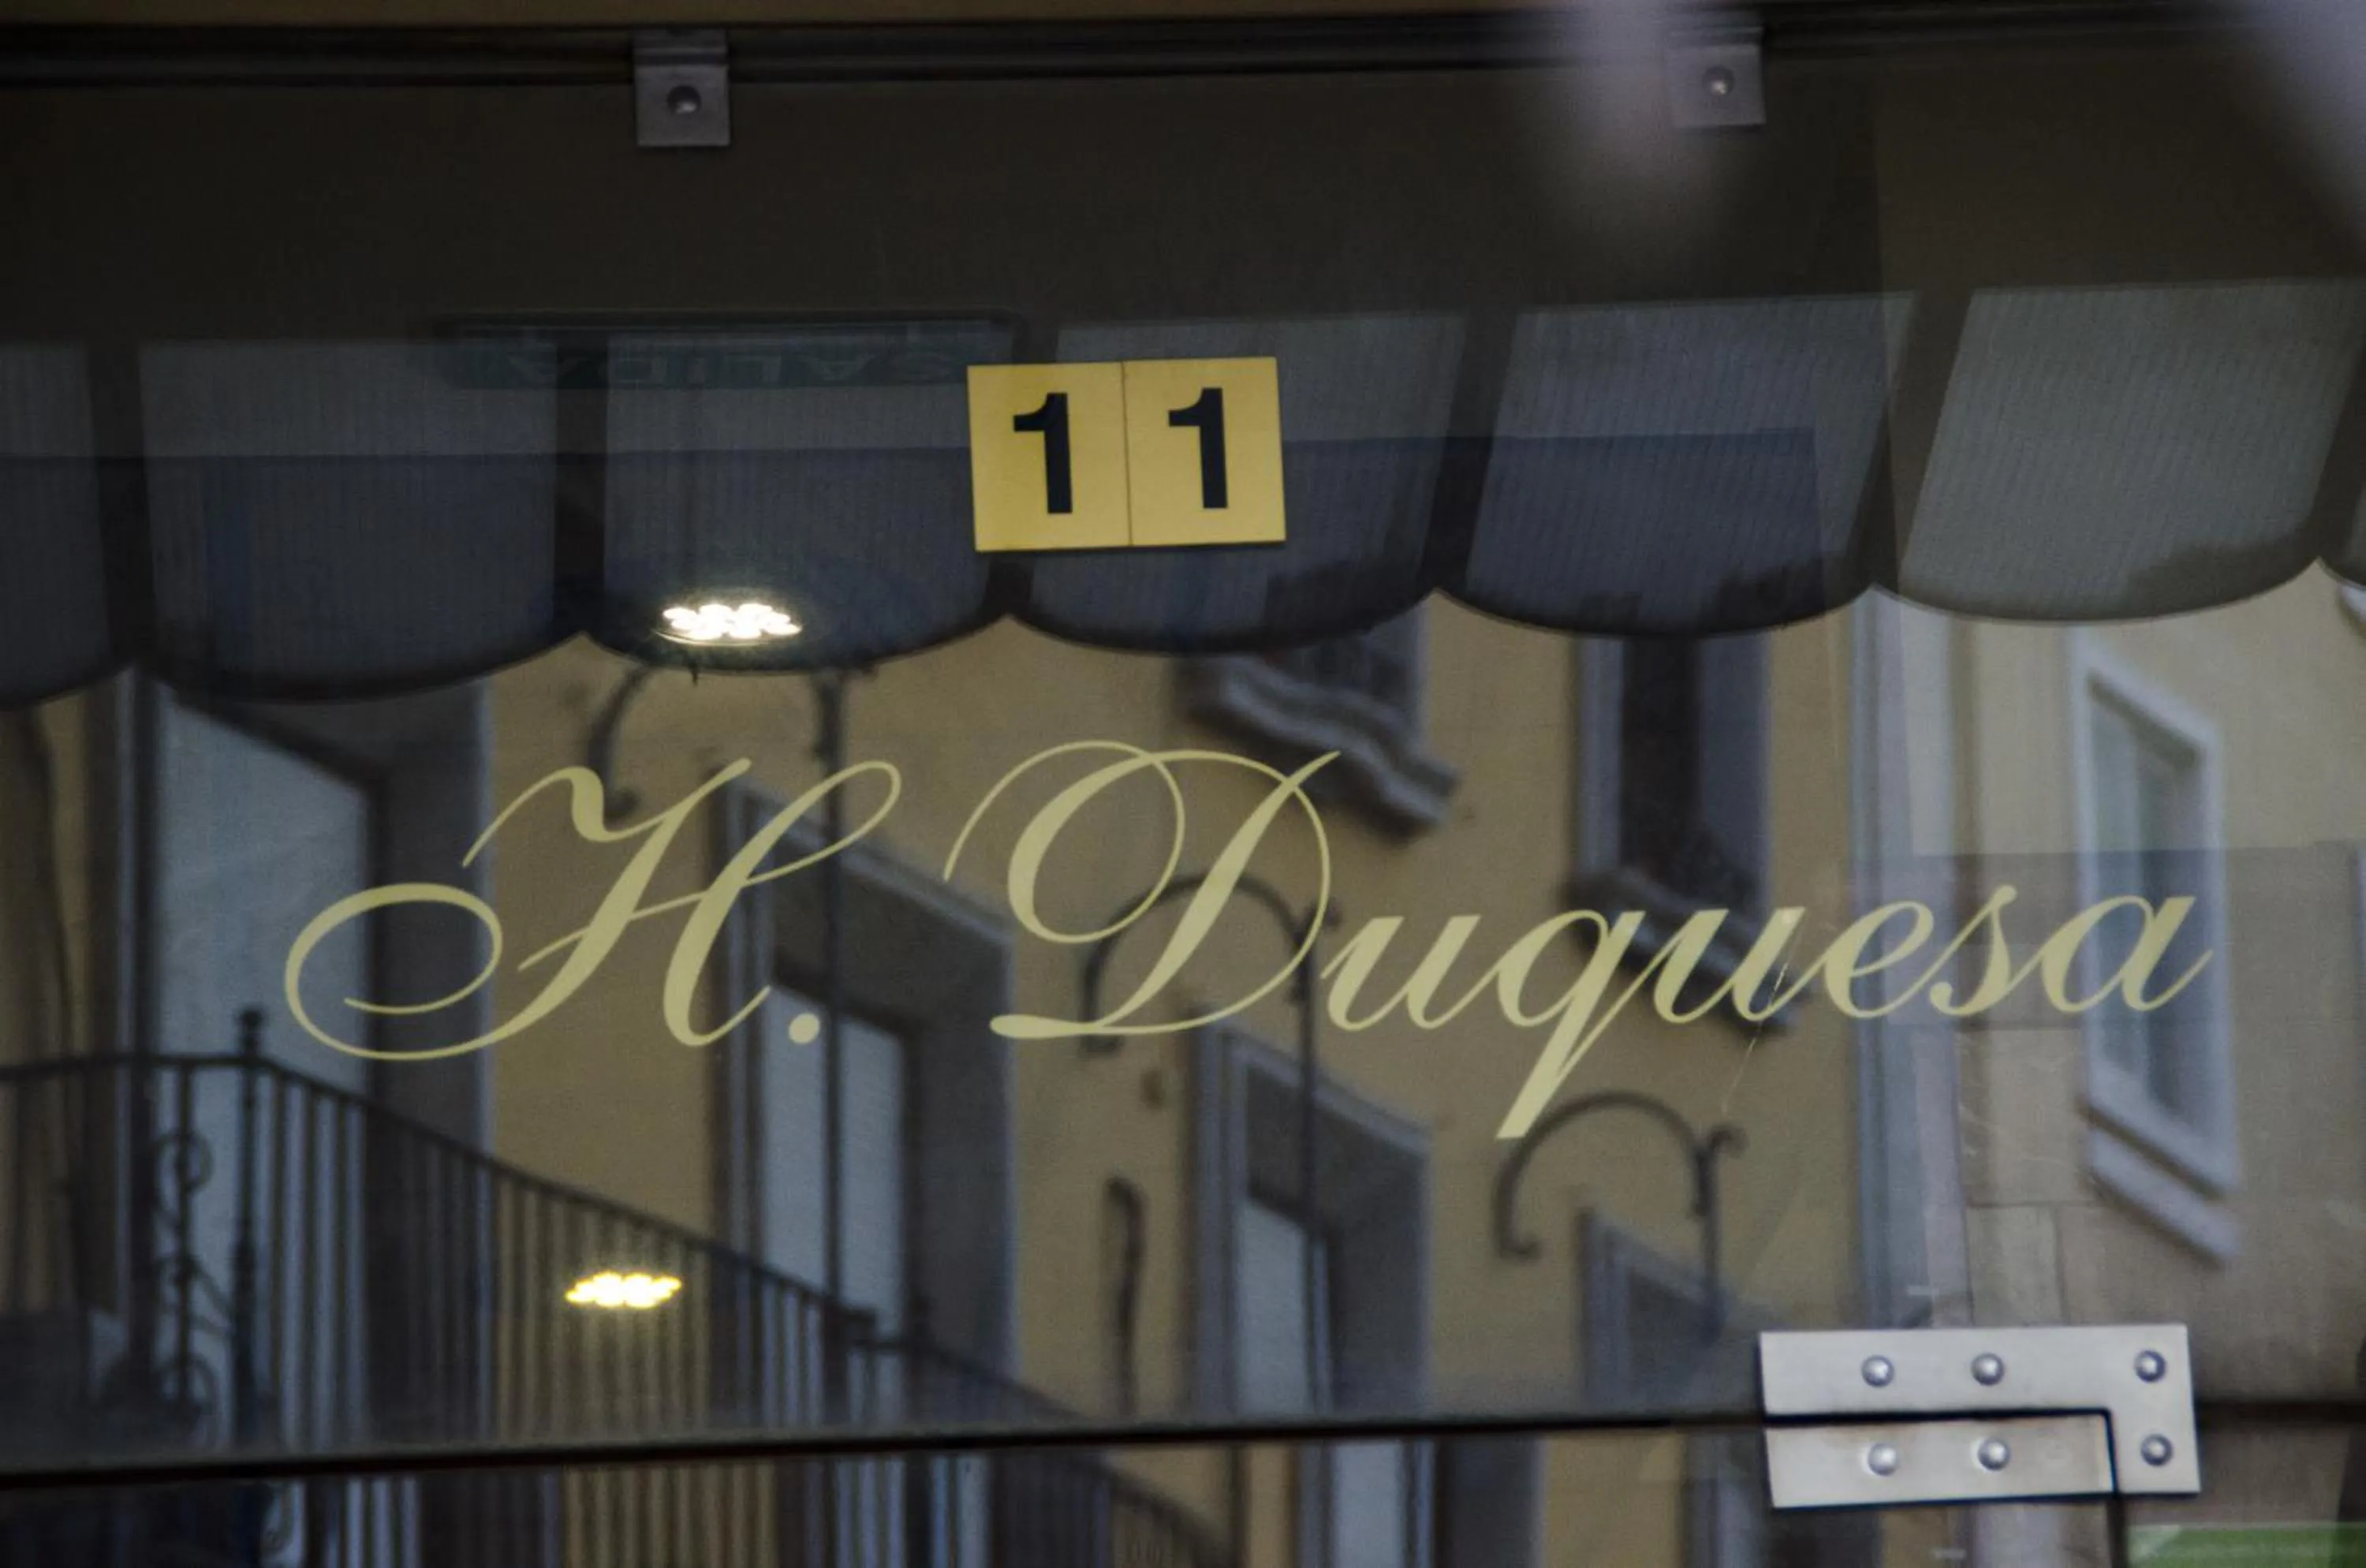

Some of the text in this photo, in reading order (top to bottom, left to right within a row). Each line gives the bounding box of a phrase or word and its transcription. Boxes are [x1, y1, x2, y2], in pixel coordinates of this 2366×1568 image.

[1013, 387, 1228, 514] 11
[284, 739, 2213, 1141] H. Duquesa
